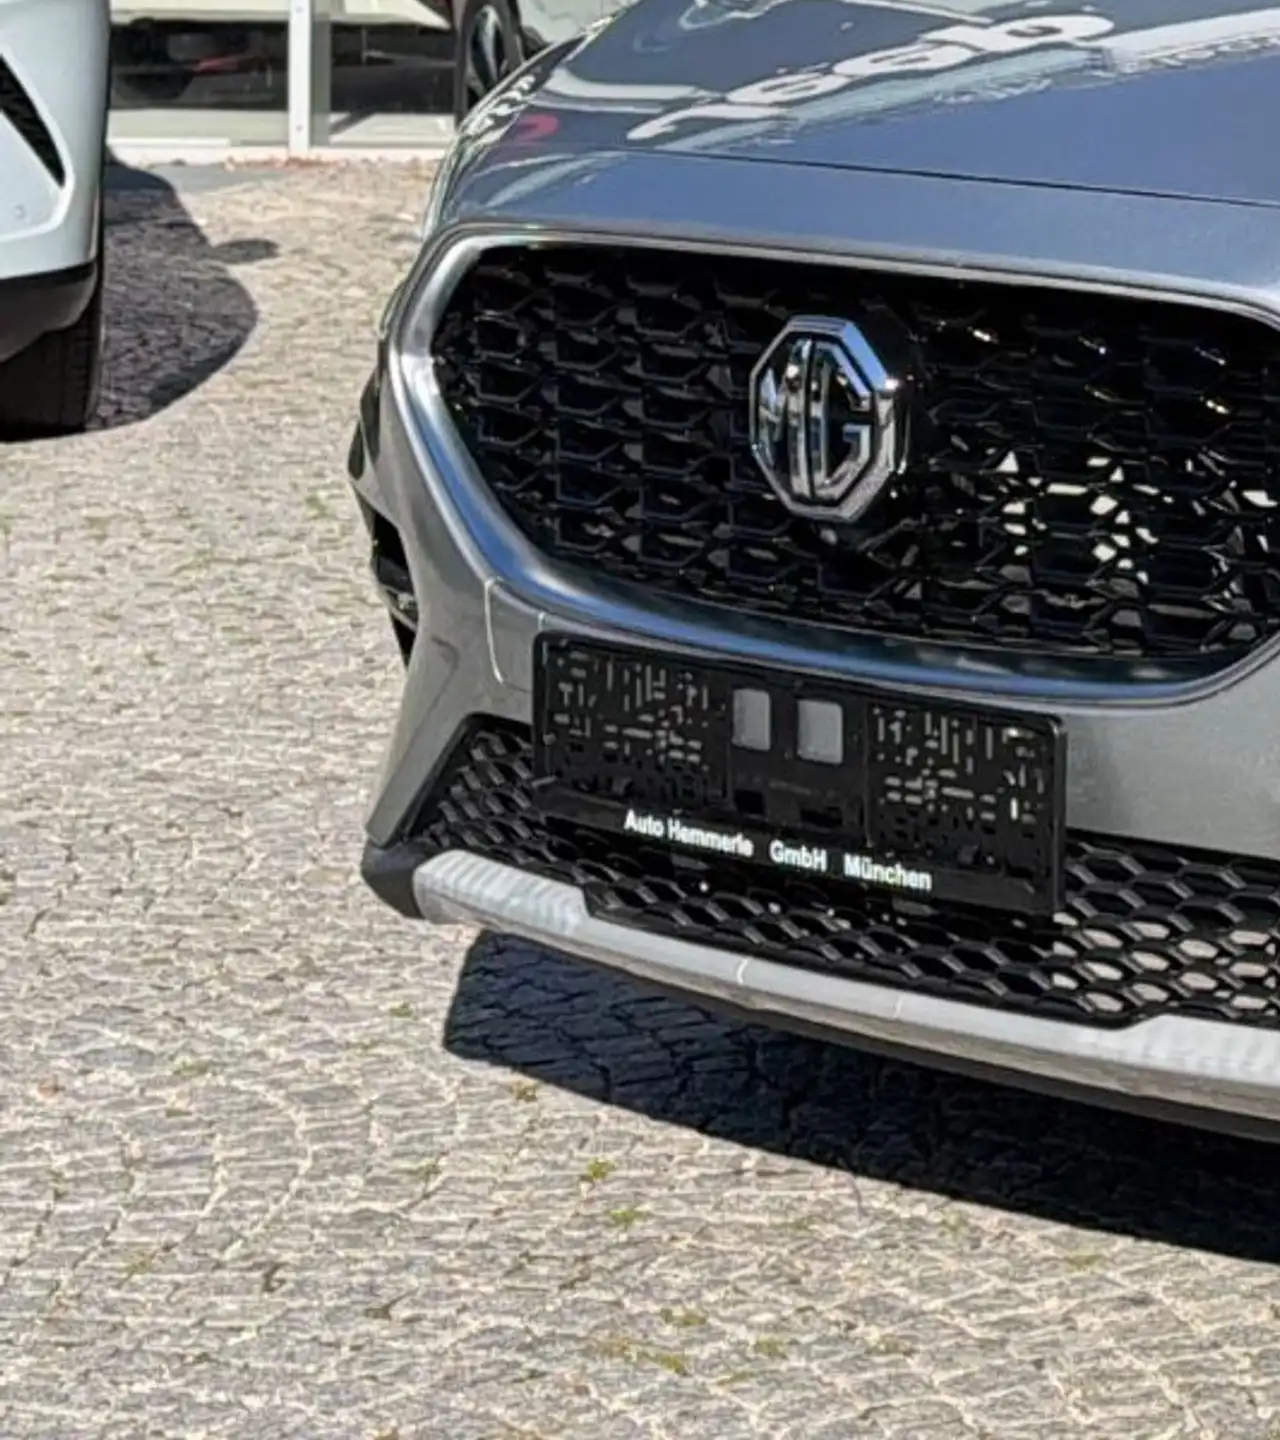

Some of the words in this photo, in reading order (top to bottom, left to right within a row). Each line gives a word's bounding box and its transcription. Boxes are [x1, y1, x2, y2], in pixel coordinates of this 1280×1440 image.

[757, 332, 875, 504] MG
[623, 808, 665, 838] Auto
[668, 818, 754, 858] Hemmerle
[769, 839, 828, 872] GmbH
[843, 853, 933, 892] München
